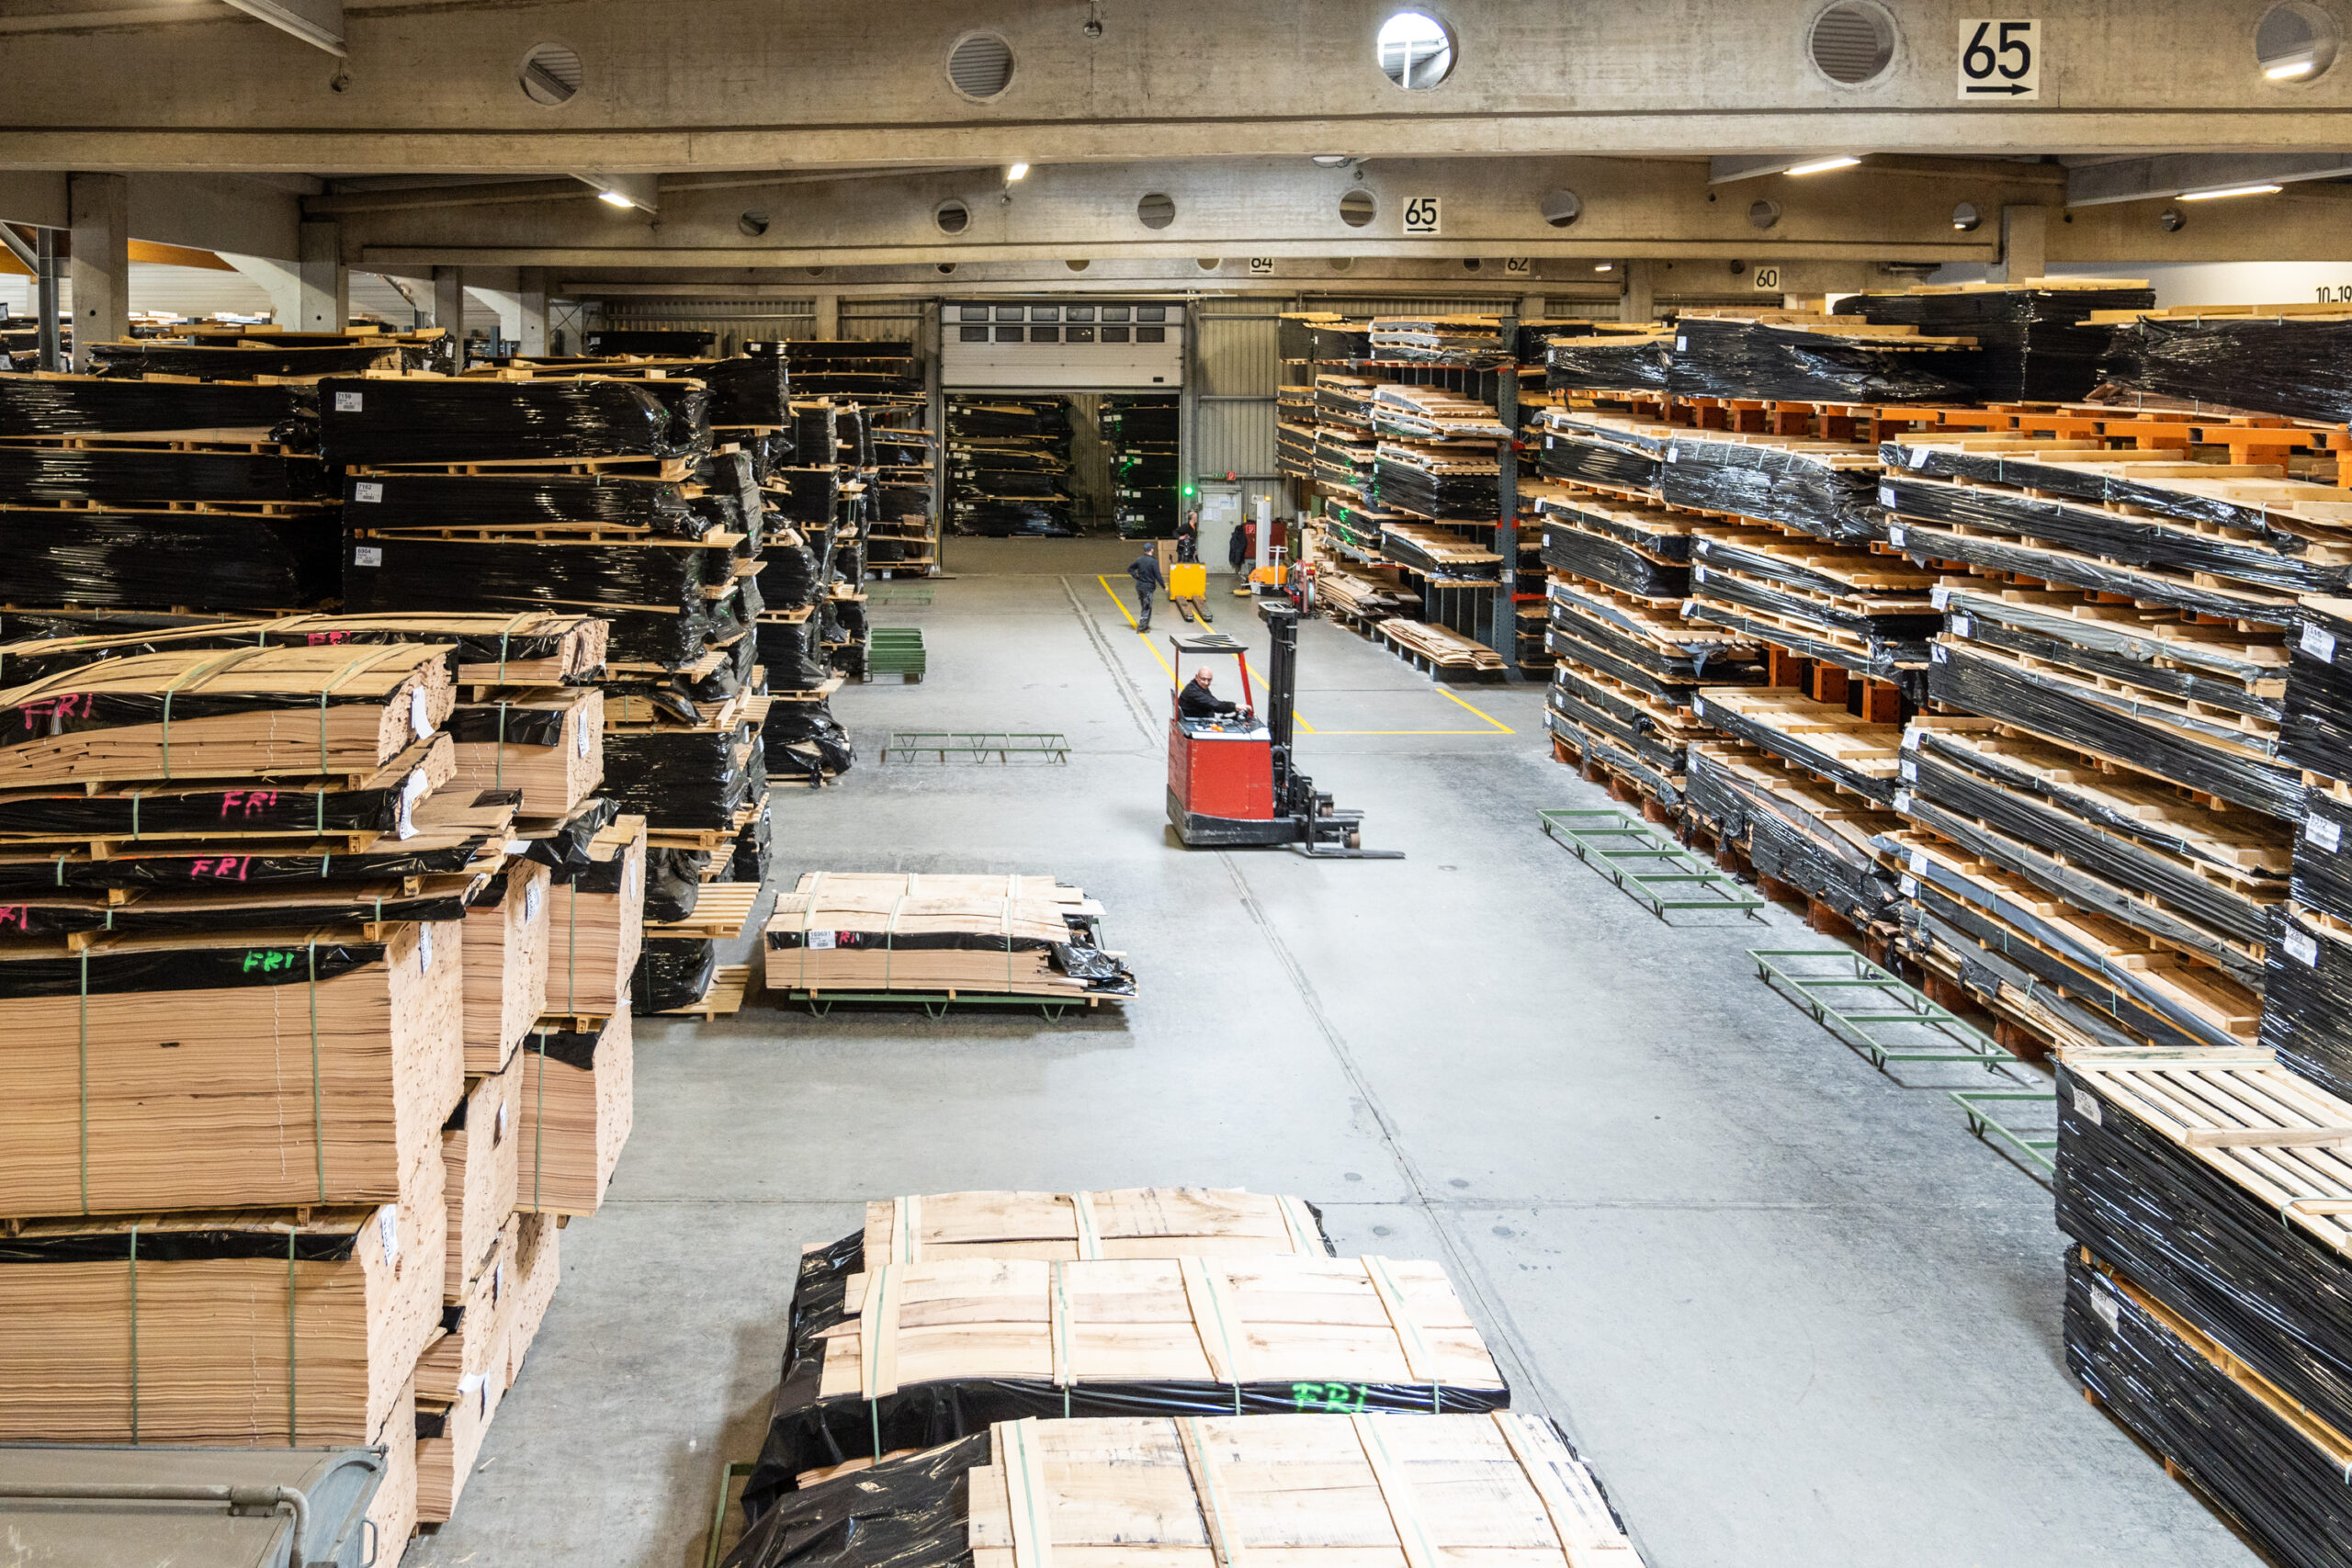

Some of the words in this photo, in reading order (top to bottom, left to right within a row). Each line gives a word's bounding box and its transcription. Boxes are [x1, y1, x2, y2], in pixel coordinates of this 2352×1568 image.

[1962, 22, 2030, 79] 65
[1406, 198, 1437, 225] 65
[1508, 257, 1528, 271] 62
[1757, 270, 1777, 287] 60
